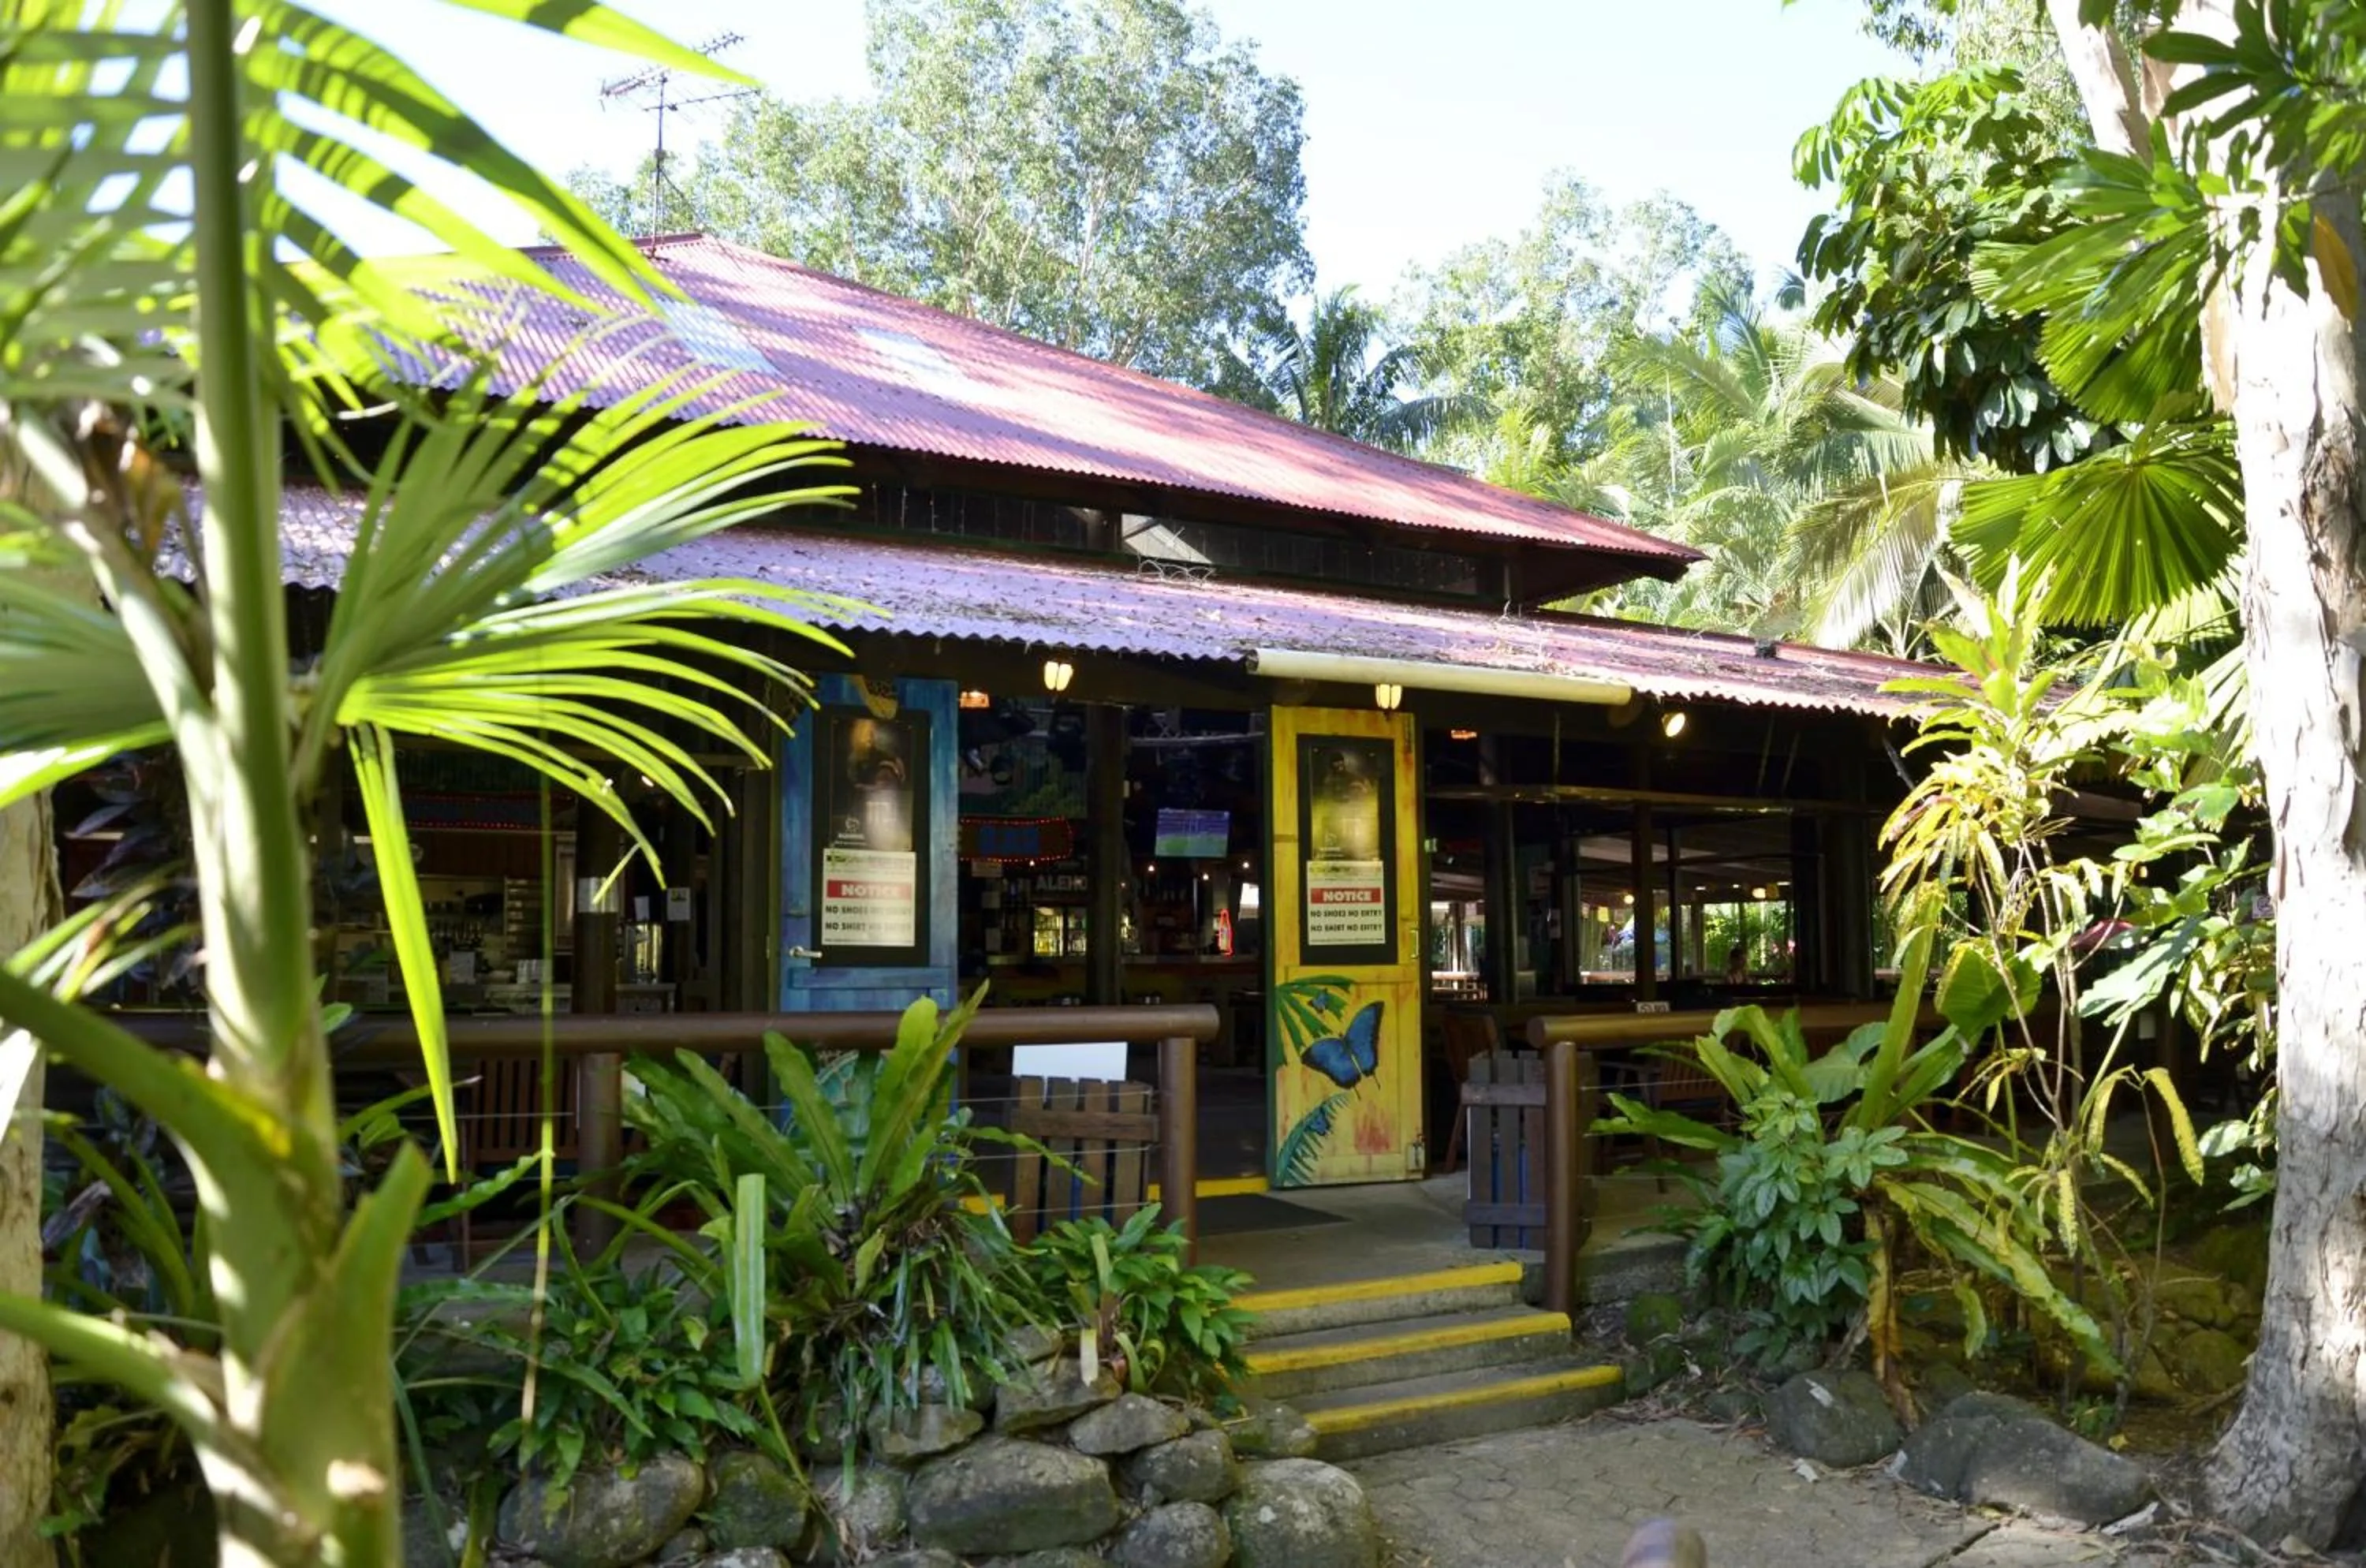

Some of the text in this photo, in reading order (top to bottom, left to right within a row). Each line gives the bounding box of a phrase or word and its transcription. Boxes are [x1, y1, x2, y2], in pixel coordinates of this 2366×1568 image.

[841, 883, 900, 898] NOTICE
[1323, 890, 1372, 902] NOTICE
[826, 922, 838, 931] NO
[842, 922, 866, 931] SHIRT
